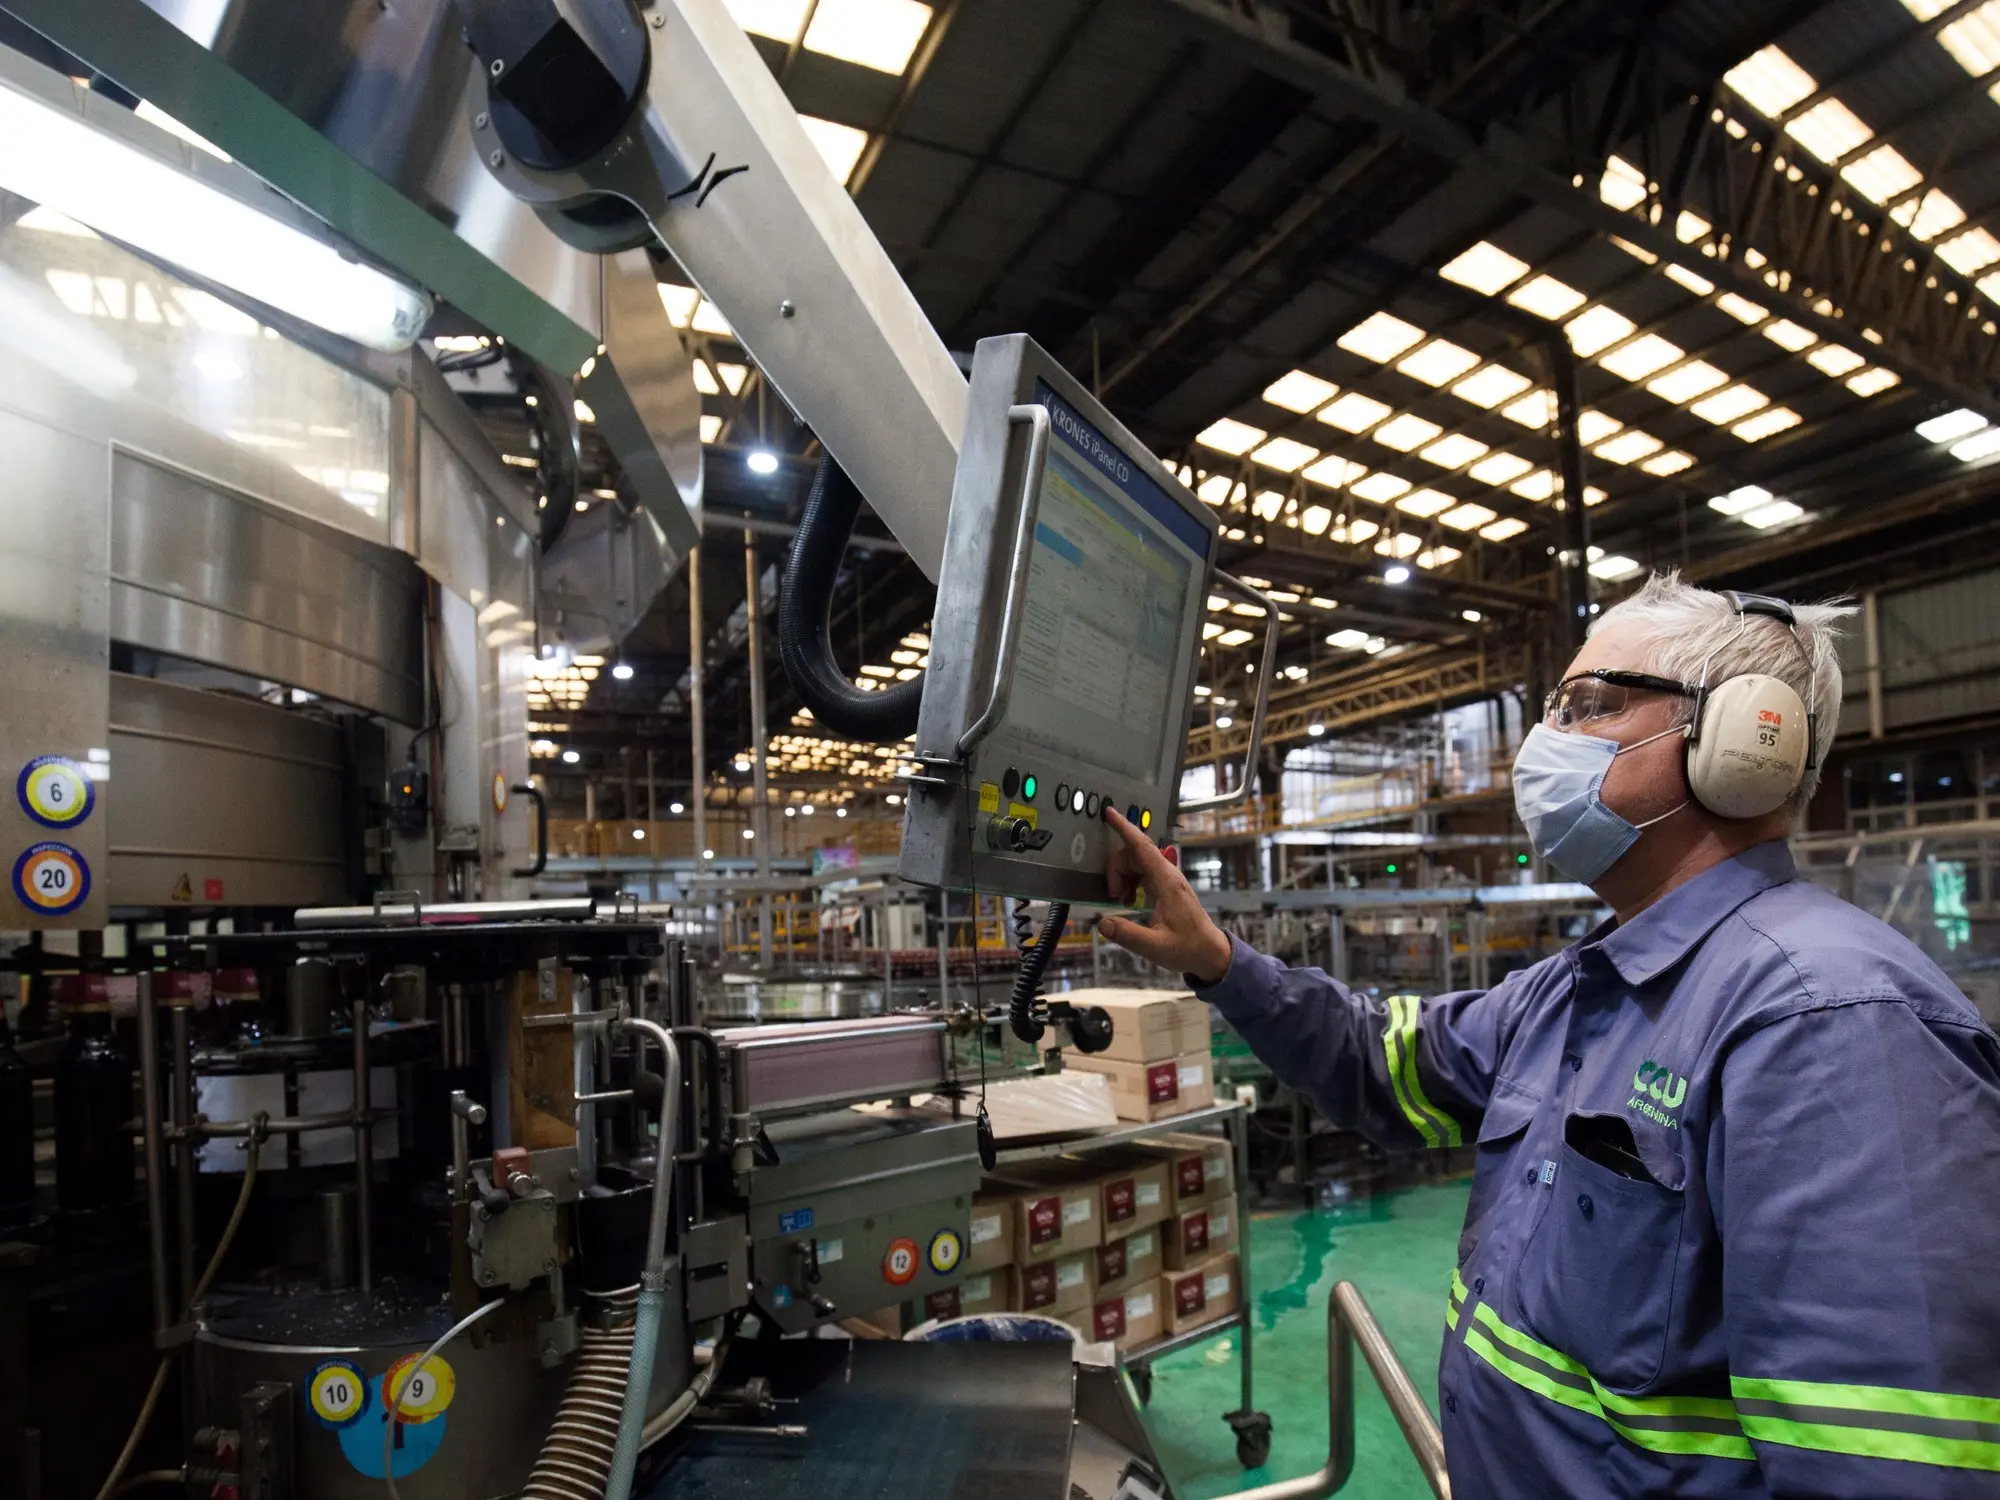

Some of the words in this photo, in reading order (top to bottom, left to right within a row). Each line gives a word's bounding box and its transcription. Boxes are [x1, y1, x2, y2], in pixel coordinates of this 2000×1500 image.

[1053, 405, 1091, 449] KRONES
[1092, 439, 1117, 473] iPanel
[1117, 463, 1129, 483] CD
[1758, 709, 1781, 726] 3M
[1759, 732, 1776, 747] 95
[50, 782, 62, 802] 6
[41, 868, 66, 889] 20
[1633, 1061, 1687, 1108] CCU
[943, 1245, 950, 1258] 9
[894, 1254, 908, 1270] 12
[325, 1383, 348, 1404] 10
[411, 1379, 424, 1399] 9
